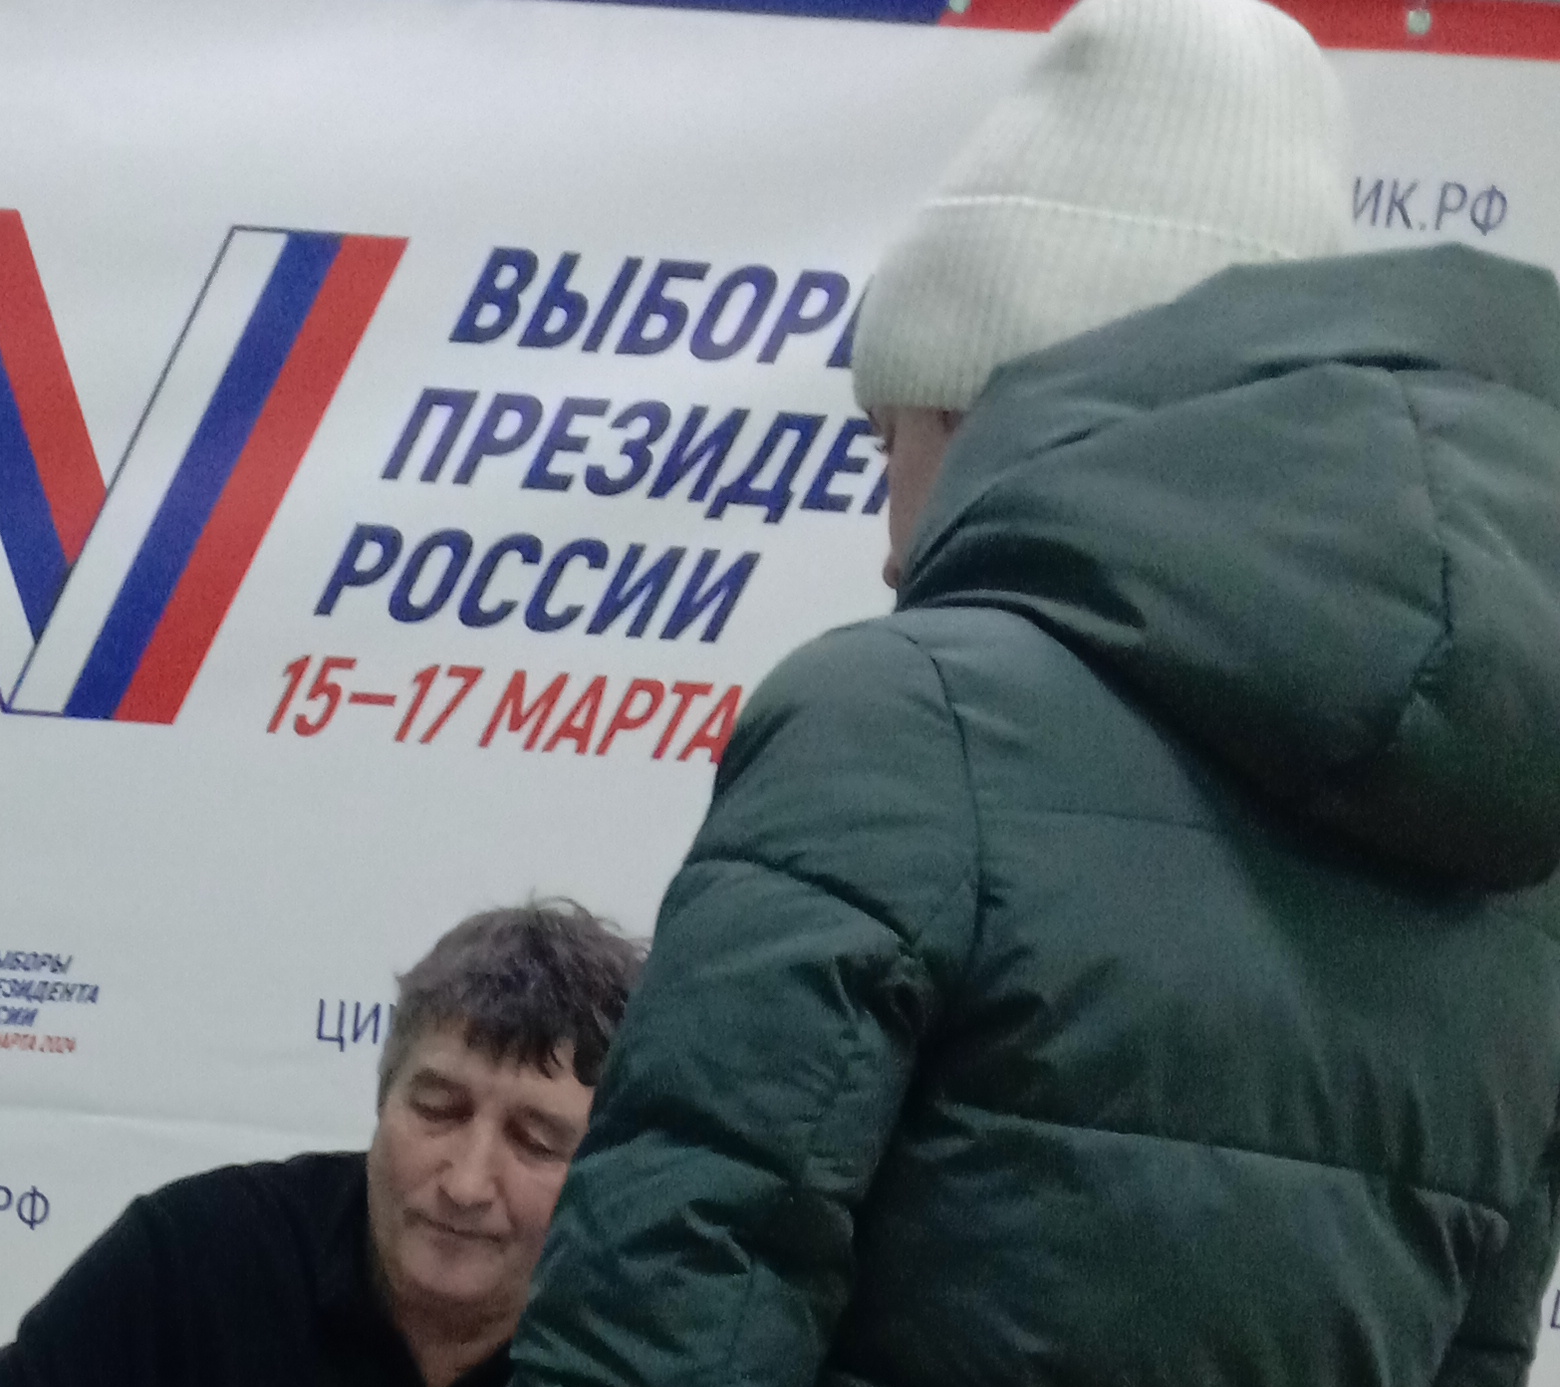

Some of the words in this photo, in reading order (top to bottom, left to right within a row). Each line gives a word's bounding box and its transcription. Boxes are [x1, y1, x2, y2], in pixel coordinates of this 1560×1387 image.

[1352, 177, 1508, 236] ИК.РФ
[448, 246, 874, 370] ВЫБОР
[382, 387, 890, 525] ПРЕЗИДЕ
[313, 521, 760, 645] РОССИИ
[477, 669, 747, 765] МАРТА
